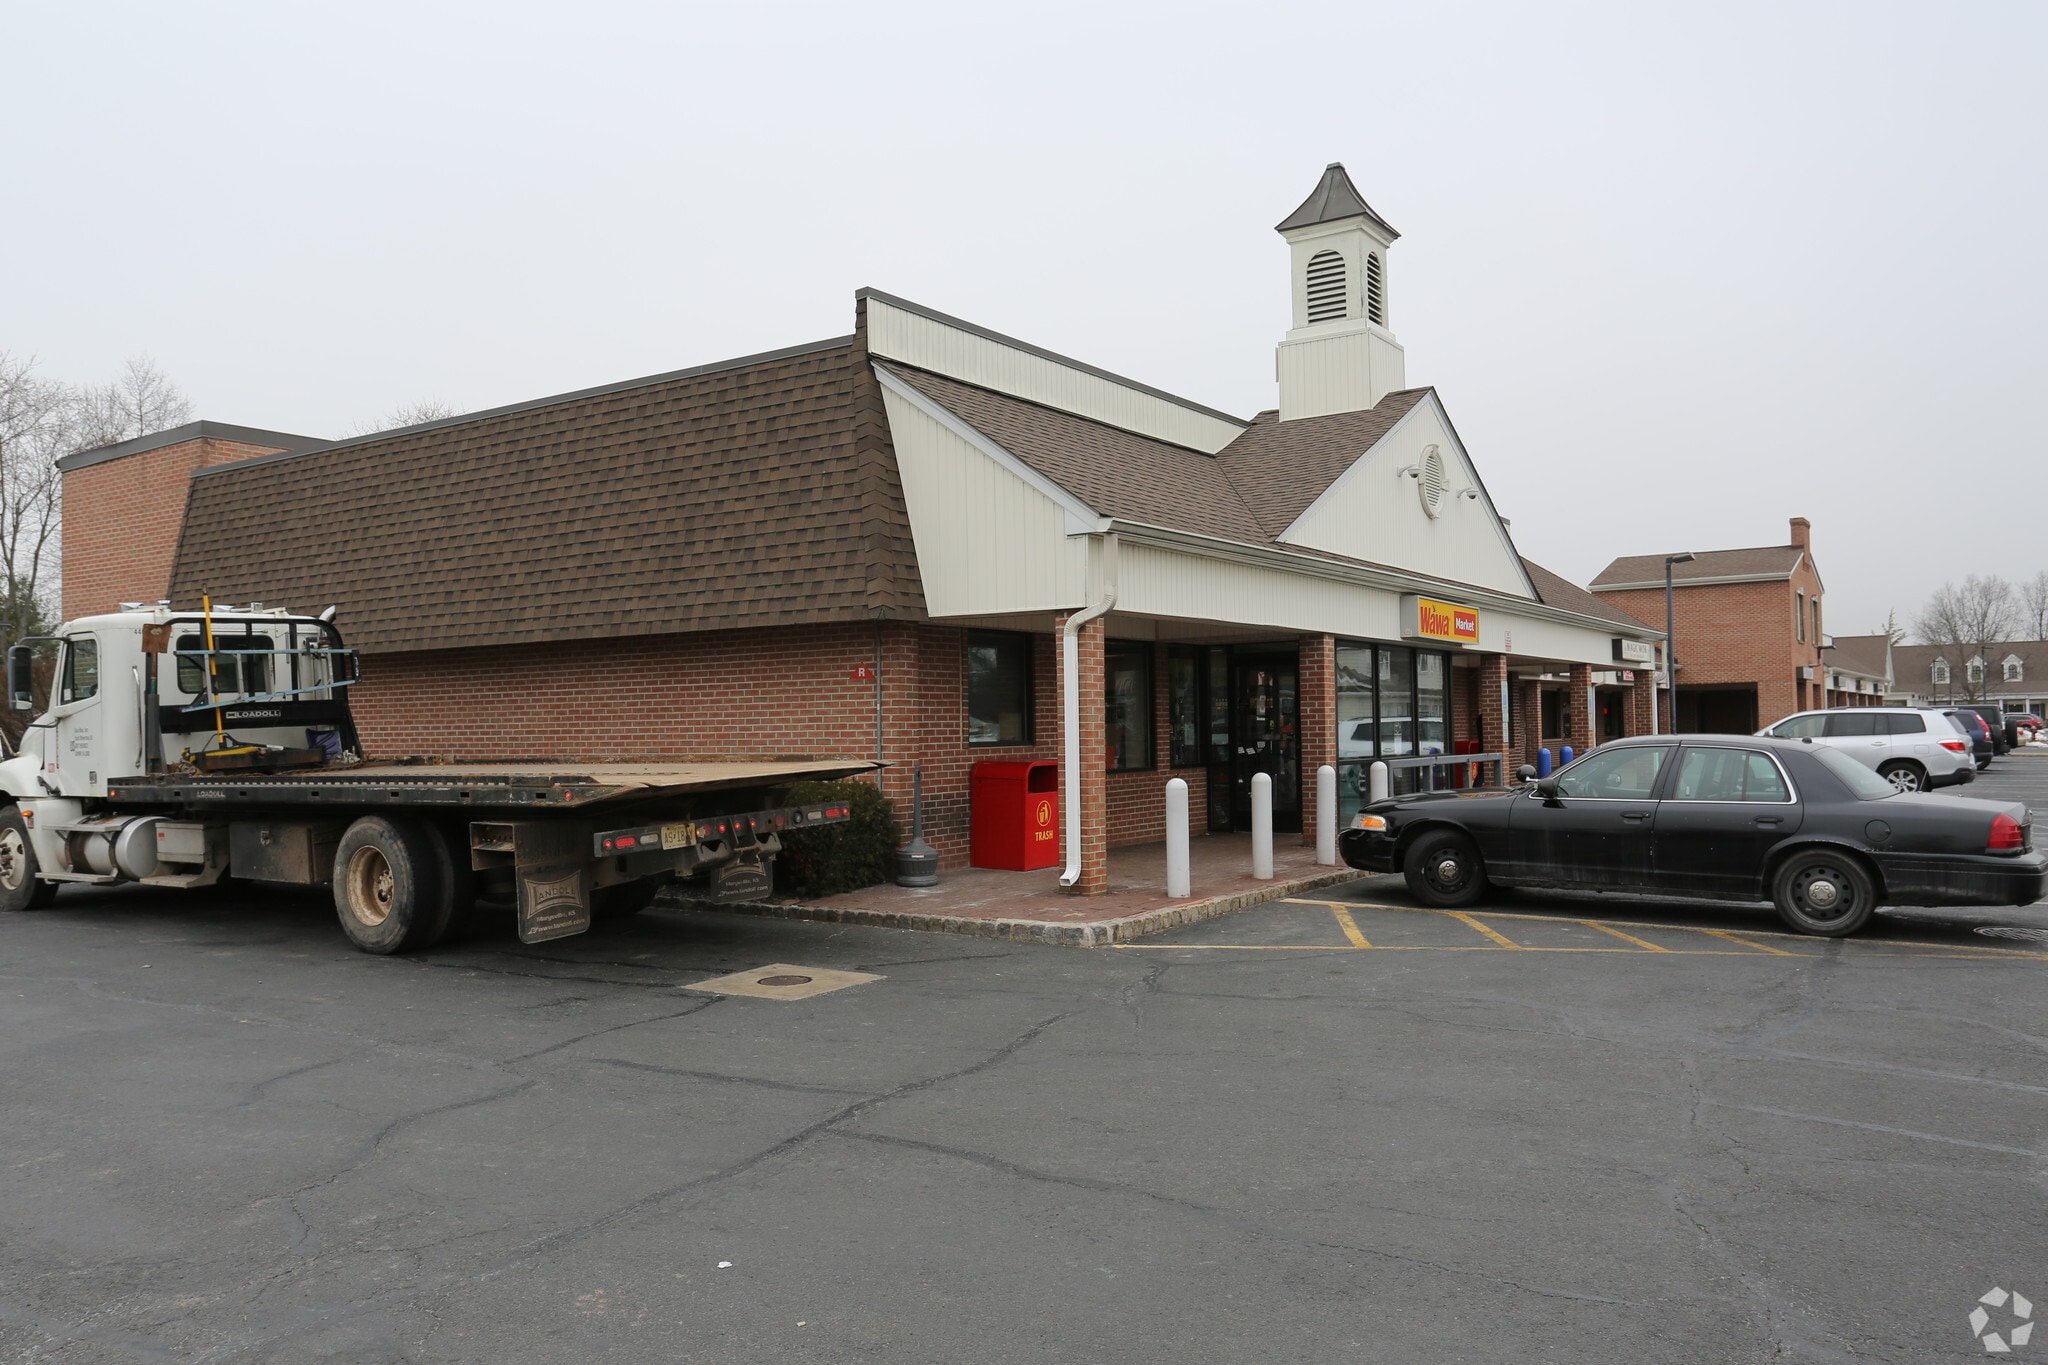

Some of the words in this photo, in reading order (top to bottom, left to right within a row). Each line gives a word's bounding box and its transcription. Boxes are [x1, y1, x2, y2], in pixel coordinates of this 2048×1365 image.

[1420, 607, 1449, 636] Wawa
[1456, 617, 1475, 632] Market
[858, 667, 865, 677] R
[237, 710, 279, 718] LOADOLL
[1035, 830, 1054, 842] TRASH
